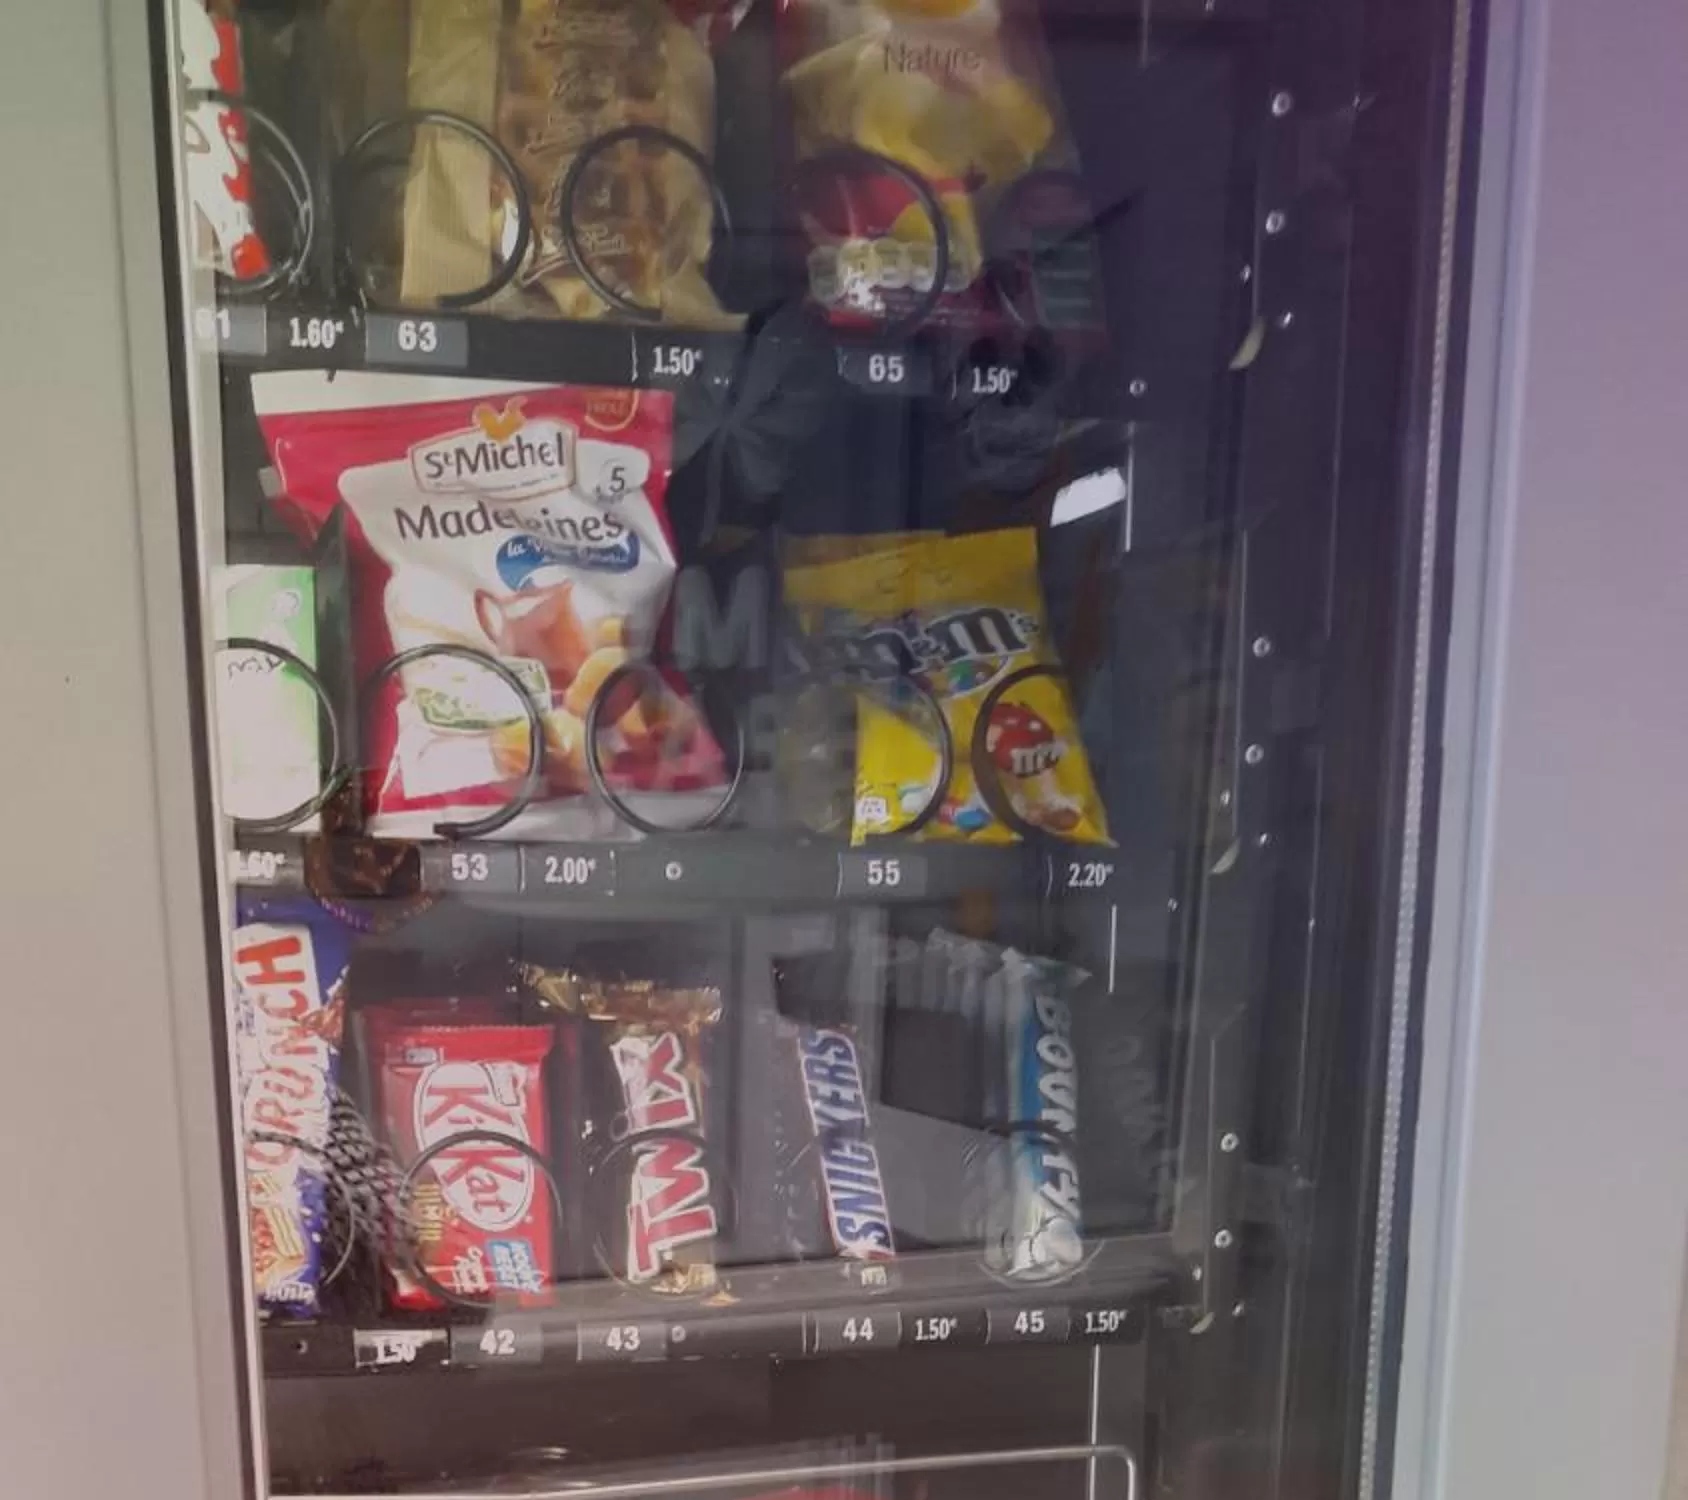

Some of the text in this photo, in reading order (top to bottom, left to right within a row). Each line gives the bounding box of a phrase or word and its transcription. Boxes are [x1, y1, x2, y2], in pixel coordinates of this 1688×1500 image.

[398, 320, 437, 352] 63
[868, 353, 904, 383] 65
[608, 467, 626, 494] 5
[451, 854, 488, 881] 53
[867, 860, 900, 886] 55
[235, 935, 316, 1168] CRUNCH
[1036, 995, 1082, 1220] BOUNTY
[612, 1032, 717, 1284] TWIX
[843, 1317, 875, 1342] 44
[1014, 1310, 1045, 1334] 45
[479, 1329, 516, 1355] 42
[606, 1325, 641, 1351] 43
